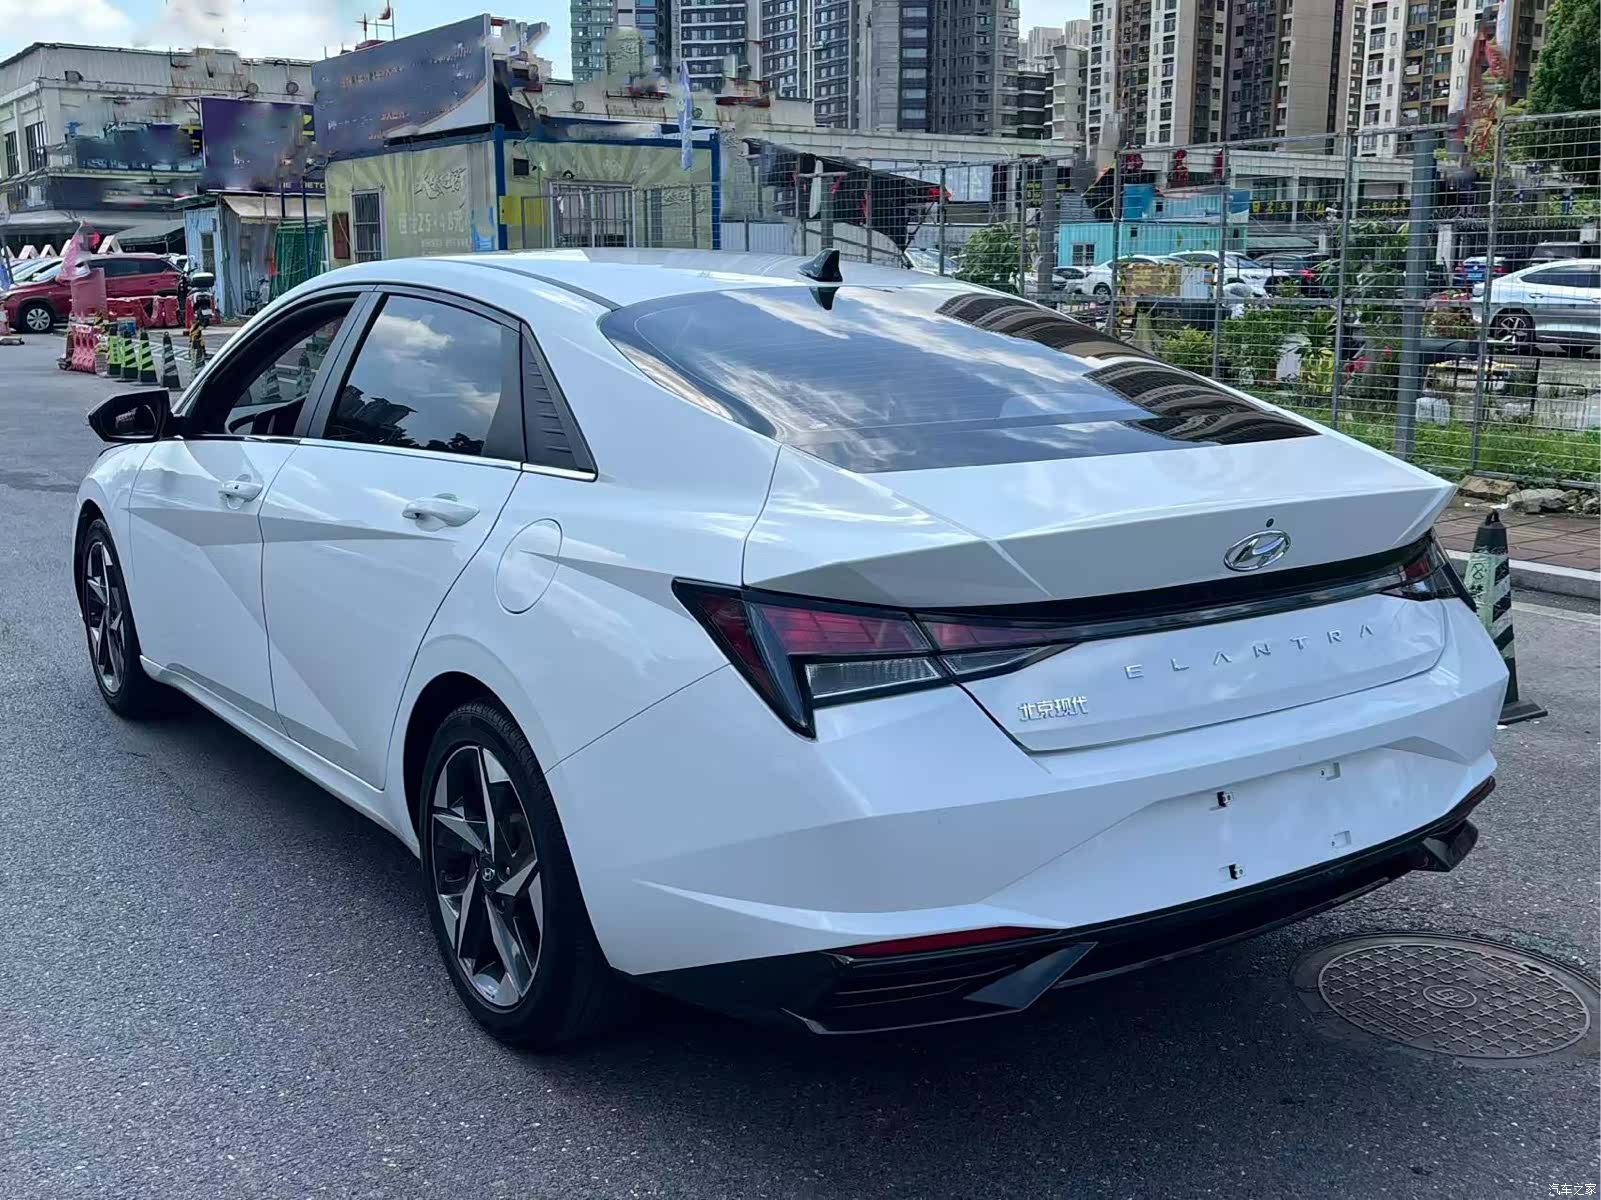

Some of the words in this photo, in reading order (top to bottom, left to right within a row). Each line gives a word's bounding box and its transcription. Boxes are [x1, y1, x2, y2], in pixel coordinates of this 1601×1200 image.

[1125, 624, 1374, 680] ELANTRA
[1017, 695, 1089, 722] 北京现代
